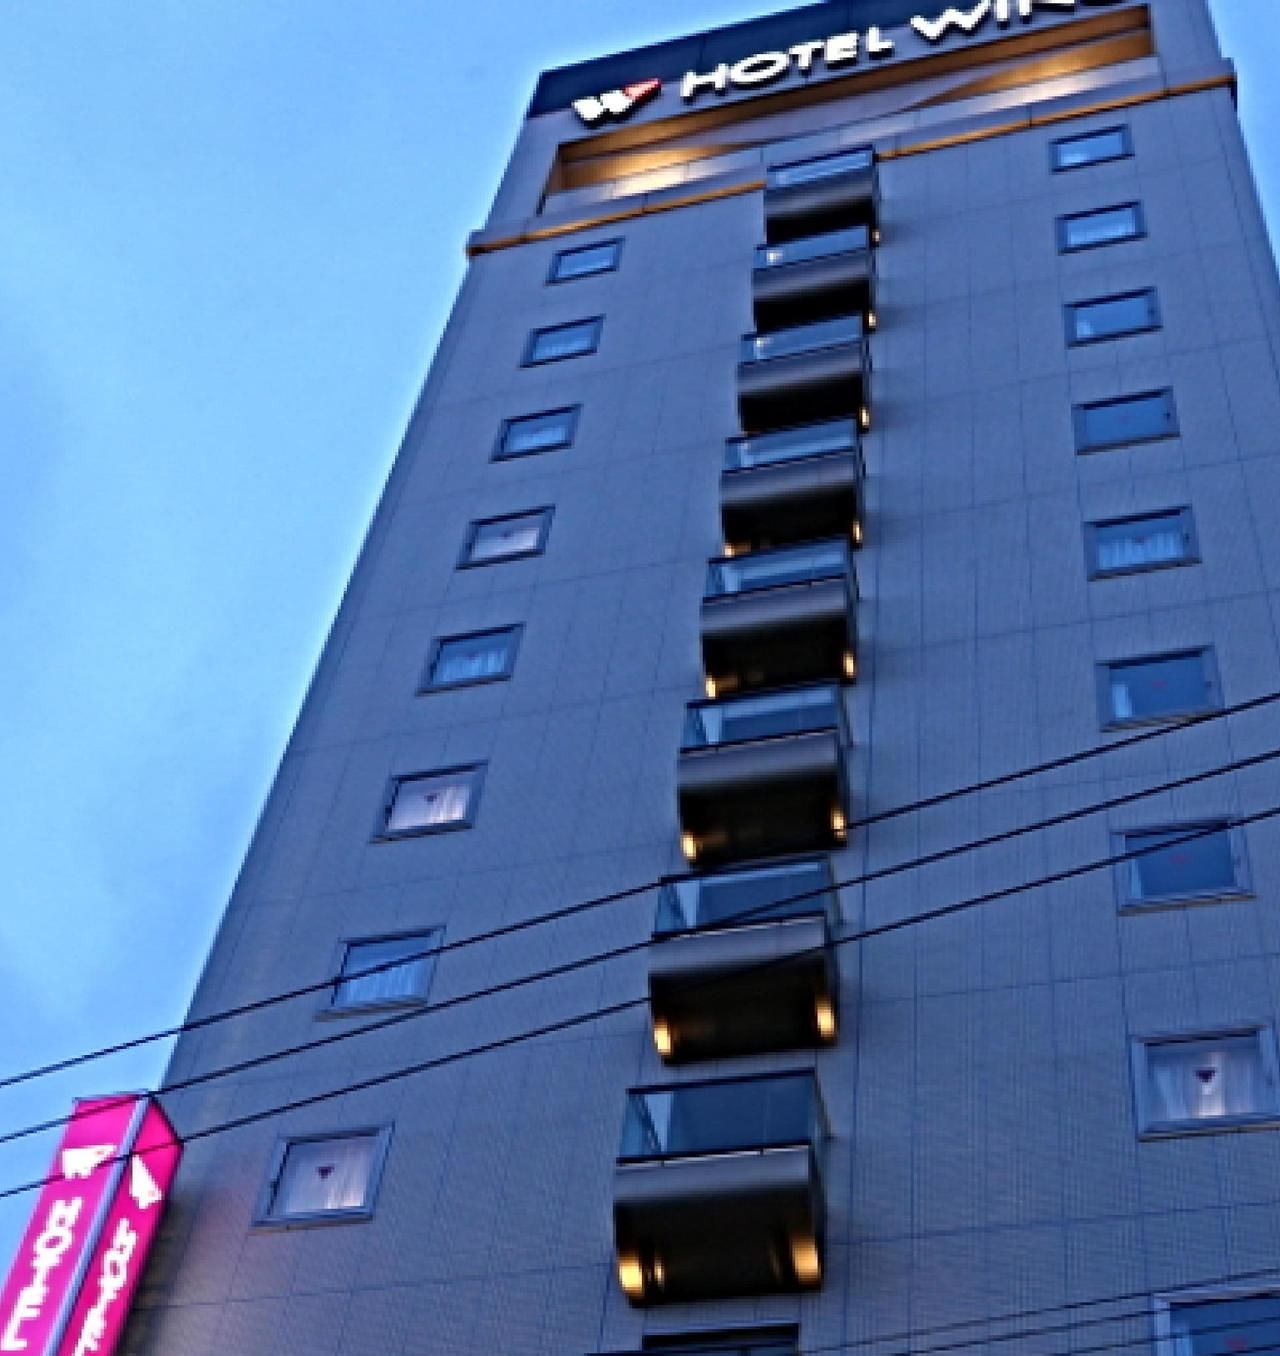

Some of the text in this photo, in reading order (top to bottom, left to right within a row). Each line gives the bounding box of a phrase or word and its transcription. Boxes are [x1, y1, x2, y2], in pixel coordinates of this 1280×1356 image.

[680, 27, 895, 98] HOTEL
[910, 0, 1074, 40] WI
[0, 1196, 83, 1351] HOTEL
